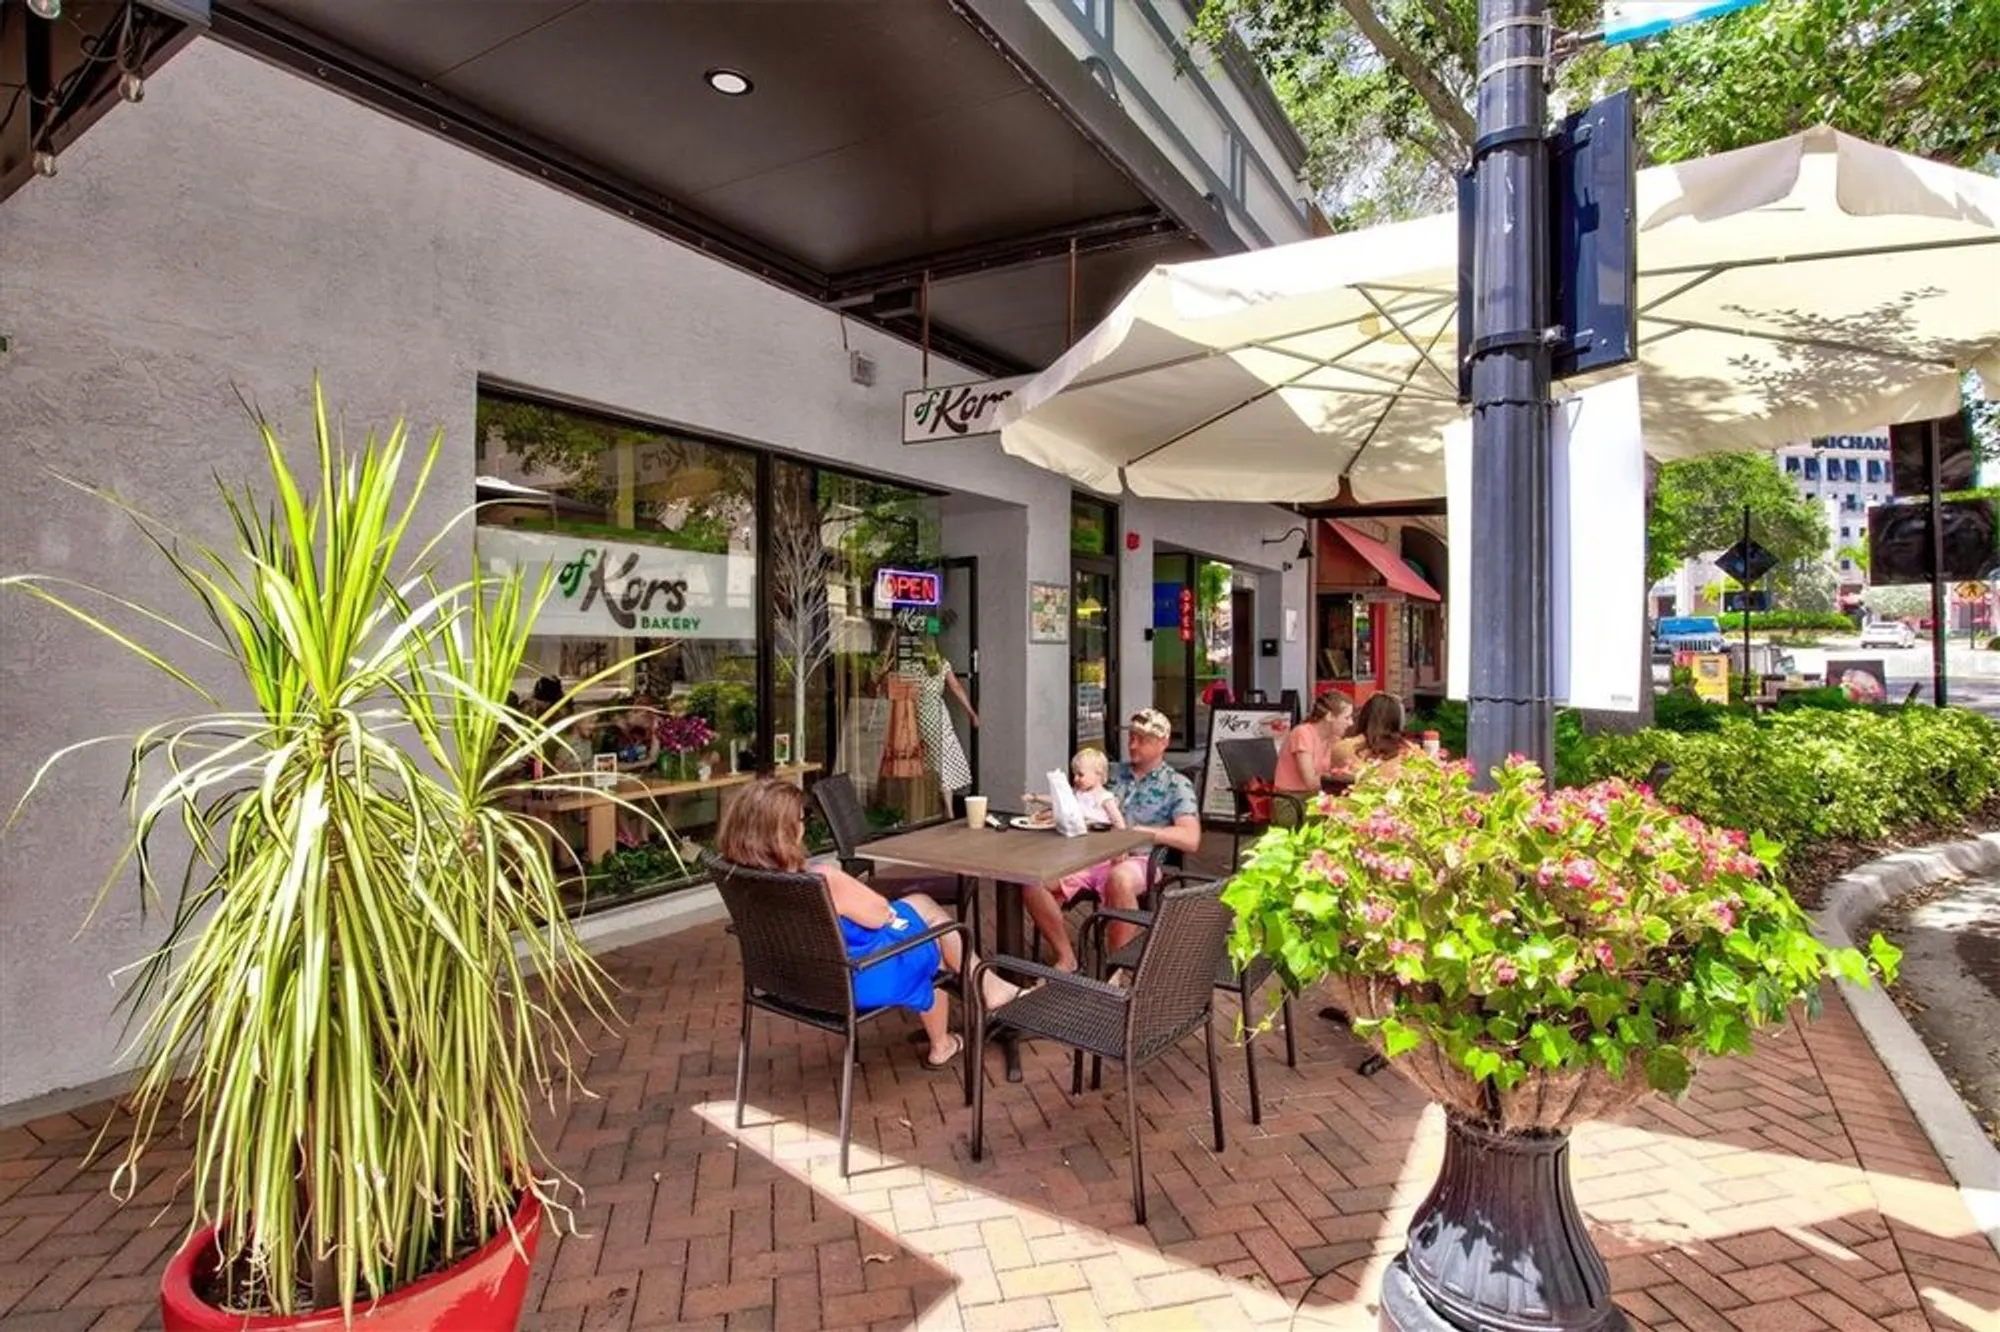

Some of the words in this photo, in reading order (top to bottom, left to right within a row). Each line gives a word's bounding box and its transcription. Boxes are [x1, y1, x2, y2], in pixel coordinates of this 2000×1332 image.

[914, 391, 939, 426] of
[558, 548, 597, 598] of
[580, 548, 688, 630] Kors
[883, 575, 934, 600] OPEN
[640, 616, 702, 631] BAKERY
